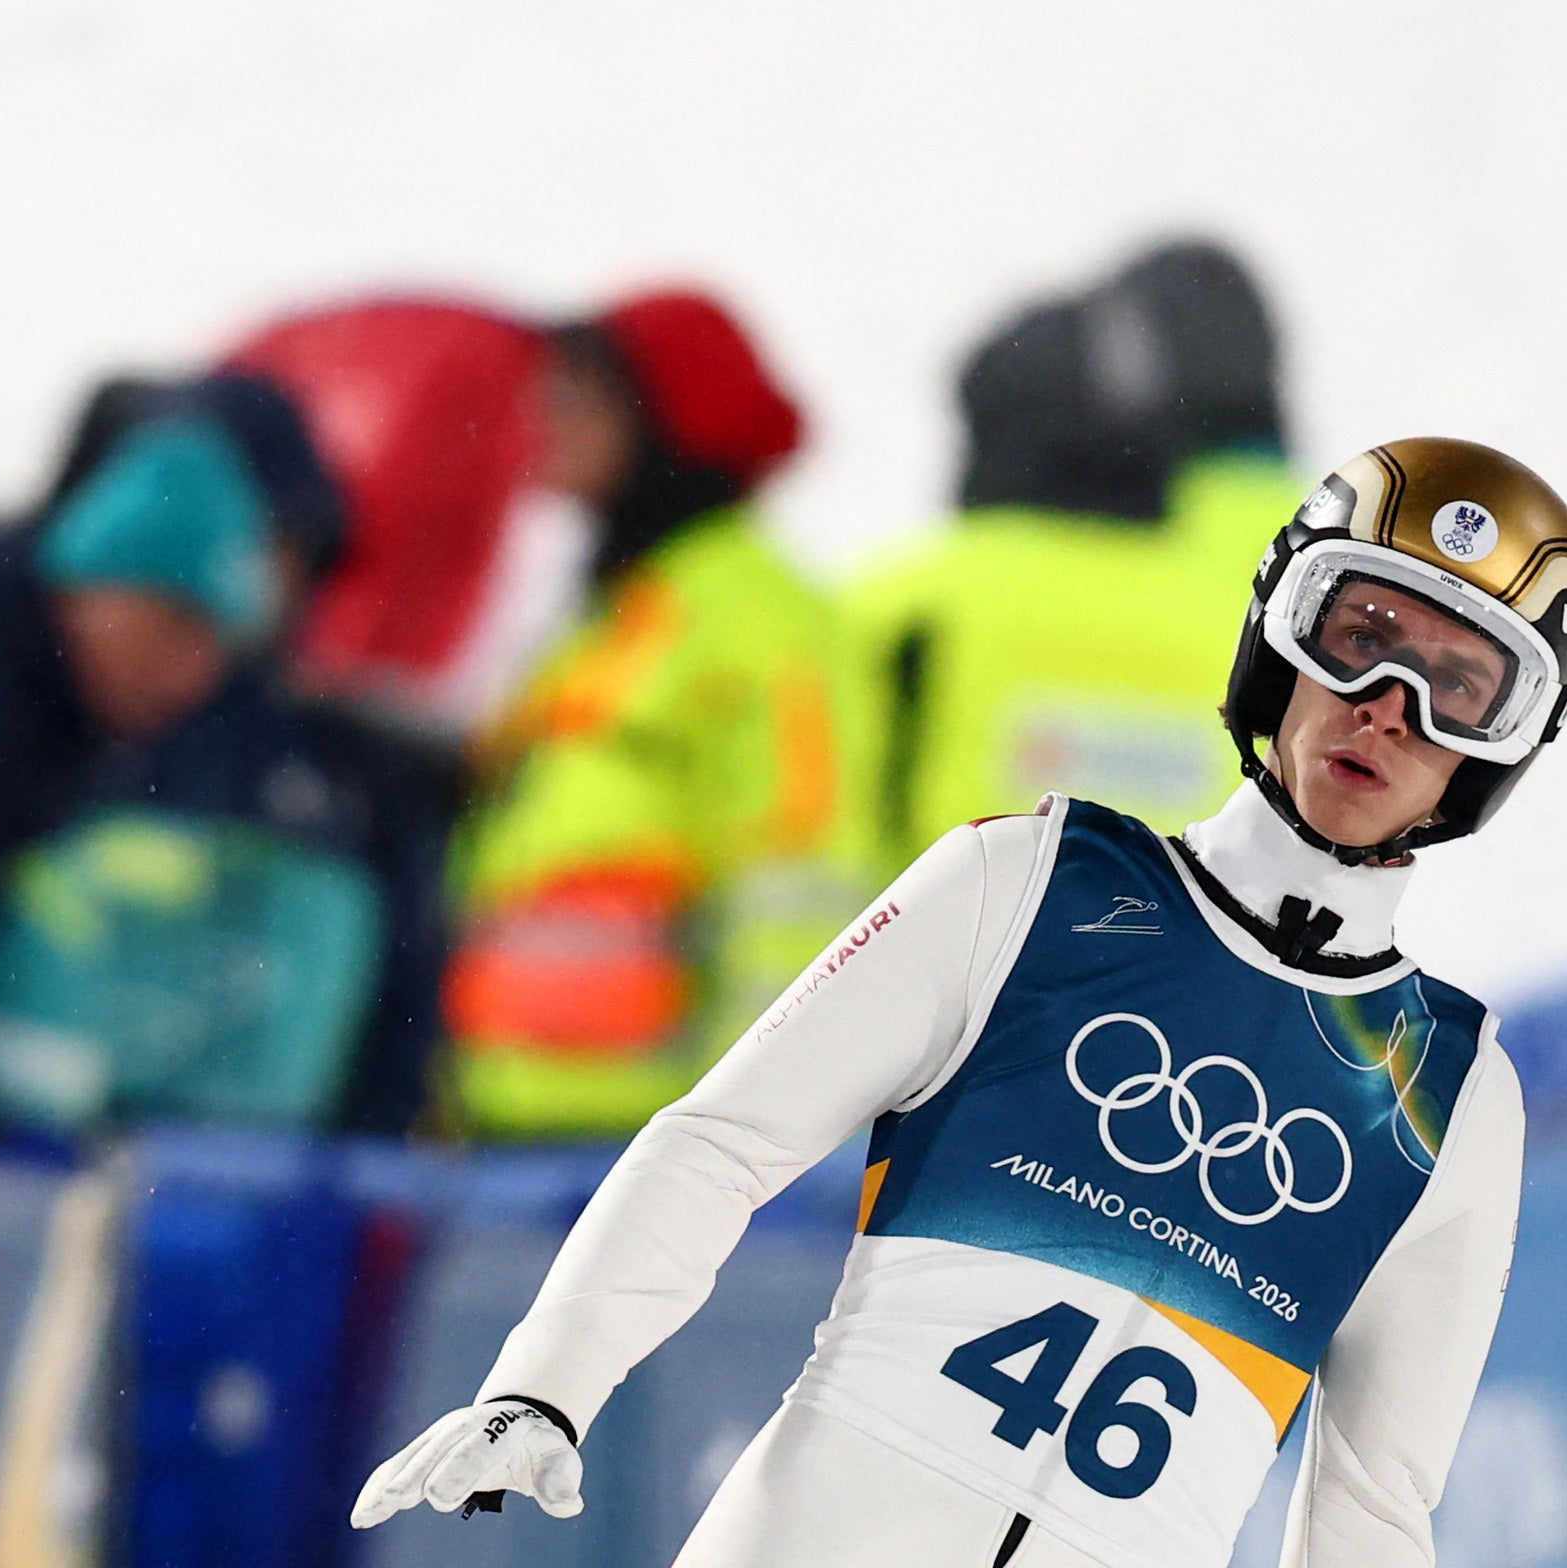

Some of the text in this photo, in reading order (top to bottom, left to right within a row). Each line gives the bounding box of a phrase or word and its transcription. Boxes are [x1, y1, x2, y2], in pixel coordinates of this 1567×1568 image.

[1303, 482, 1343, 513] vex
[1439, 574, 1464, 590] uvex
[756, 901, 902, 1043] ALPHATAURI
[989, 1154, 1303, 1322] MILANO CORTINA 2026
[940, 1301, 1198, 1500] 46
